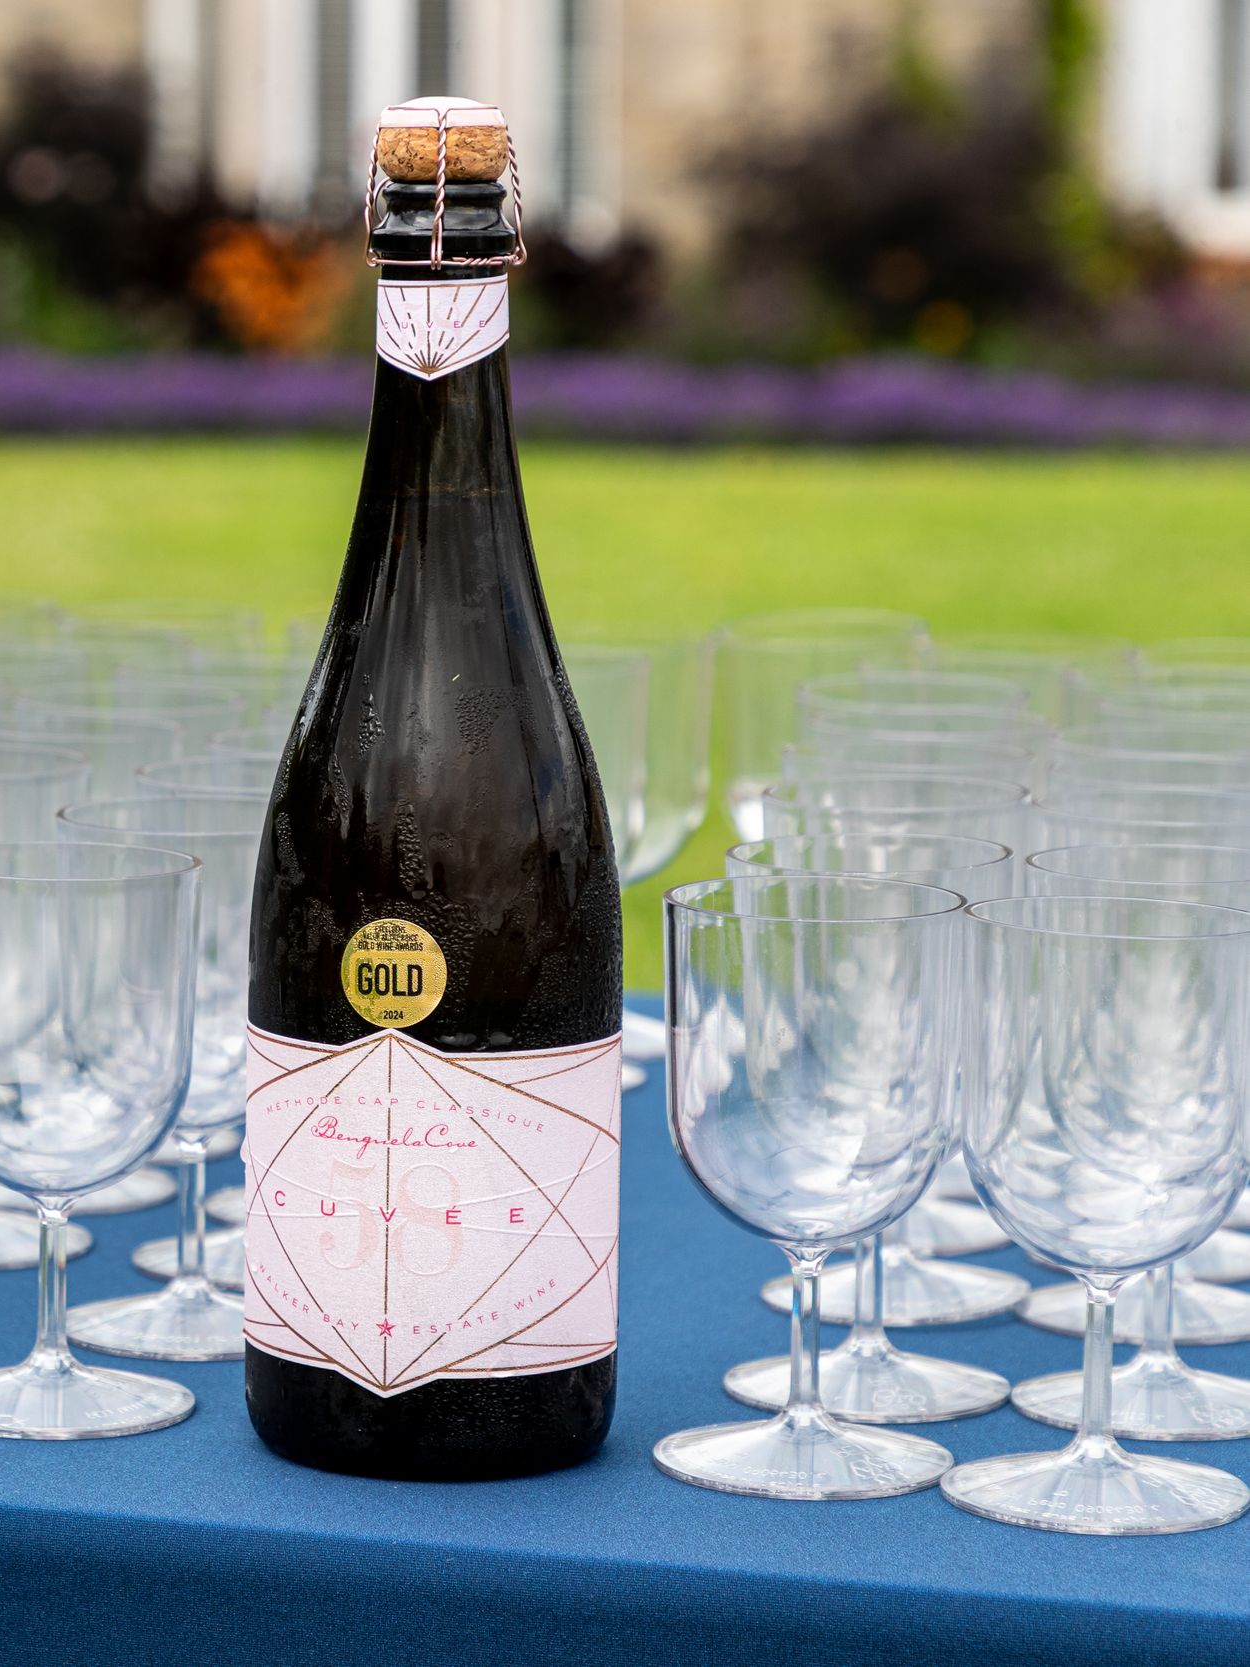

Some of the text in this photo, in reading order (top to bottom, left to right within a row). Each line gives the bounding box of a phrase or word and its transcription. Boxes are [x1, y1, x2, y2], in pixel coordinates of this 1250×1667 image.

[358, 940, 423, 951] GOLD WINE AWARDS
[357, 963, 423, 997] GOLD
[383, 1010, 404, 1020] 2024
[358, 1096, 399, 1106] CAP
[417, 1100, 545, 1133] CLASSIQUE
[274, 1190, 524, 1225] CUVÉE
[318, 1157, 464, 1276] 58
[259, 1262, 359, 1330] WALKER BAY
[412, 1278, 557, 1335] ESTATE WINE
